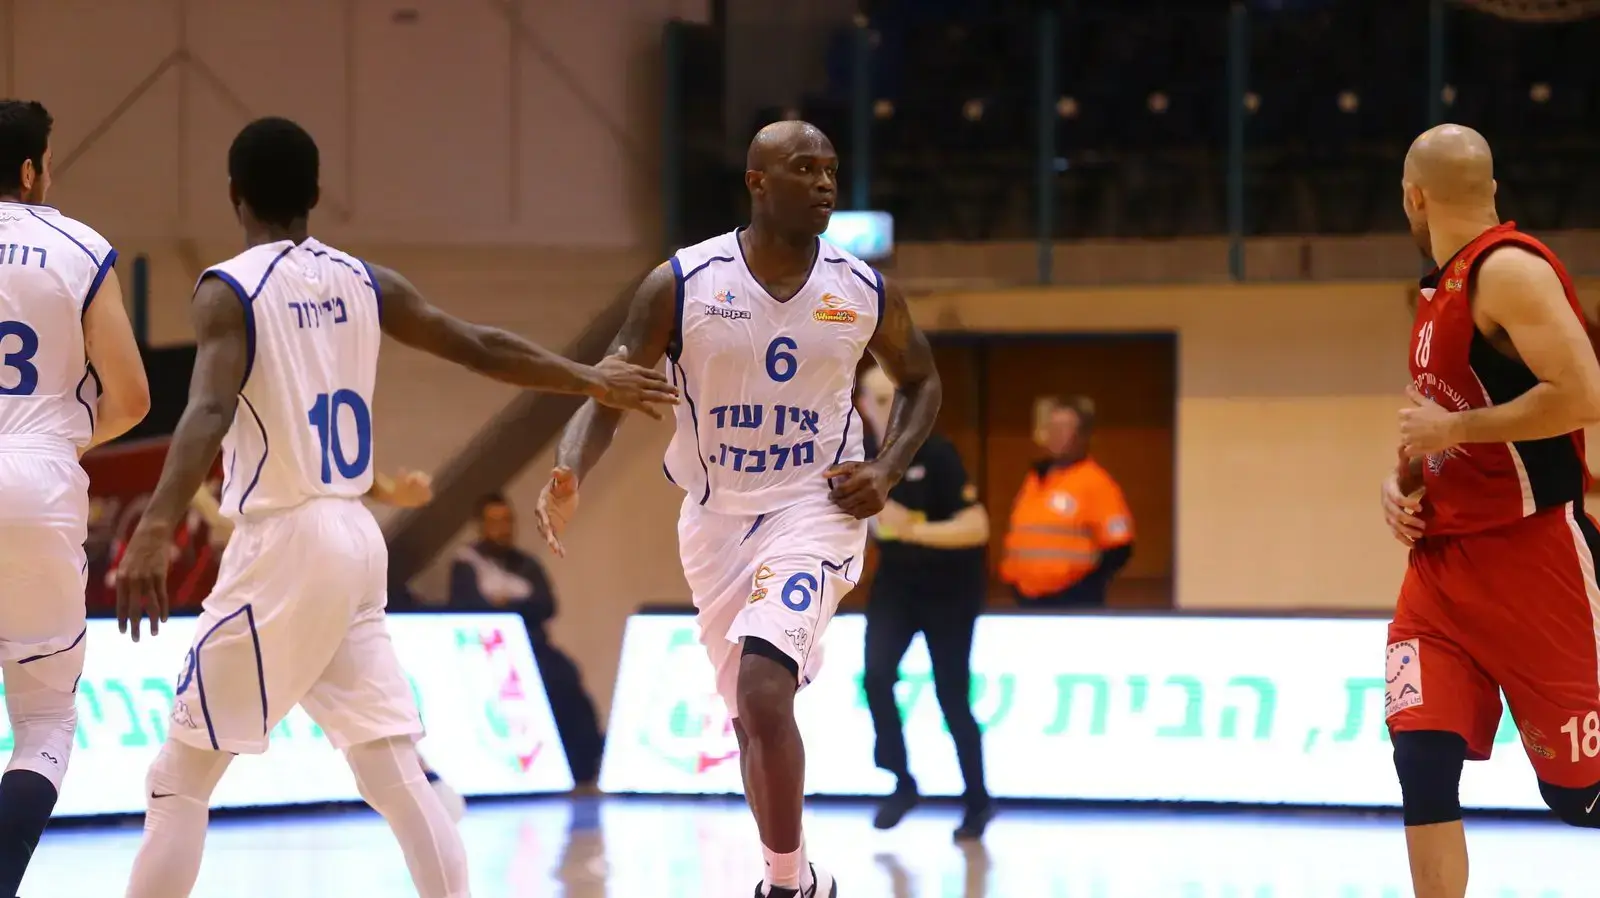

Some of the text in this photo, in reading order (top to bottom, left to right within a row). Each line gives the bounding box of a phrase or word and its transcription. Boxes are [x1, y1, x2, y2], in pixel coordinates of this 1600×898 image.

[704, 305, 751, 320] Kappa
[765, 336, 798, 383] 6
[1415, 321, 1433, 368] 18
[308, 388, 372, 484] 10
[709, 404, 820, 436] אין עוד
[709, 440, 815, 473] מלבדו.
[781, 572, 818, 612] 6
[1043, 672, 1280, 741] הבית
[1560, 711, 1600, 763] 18
